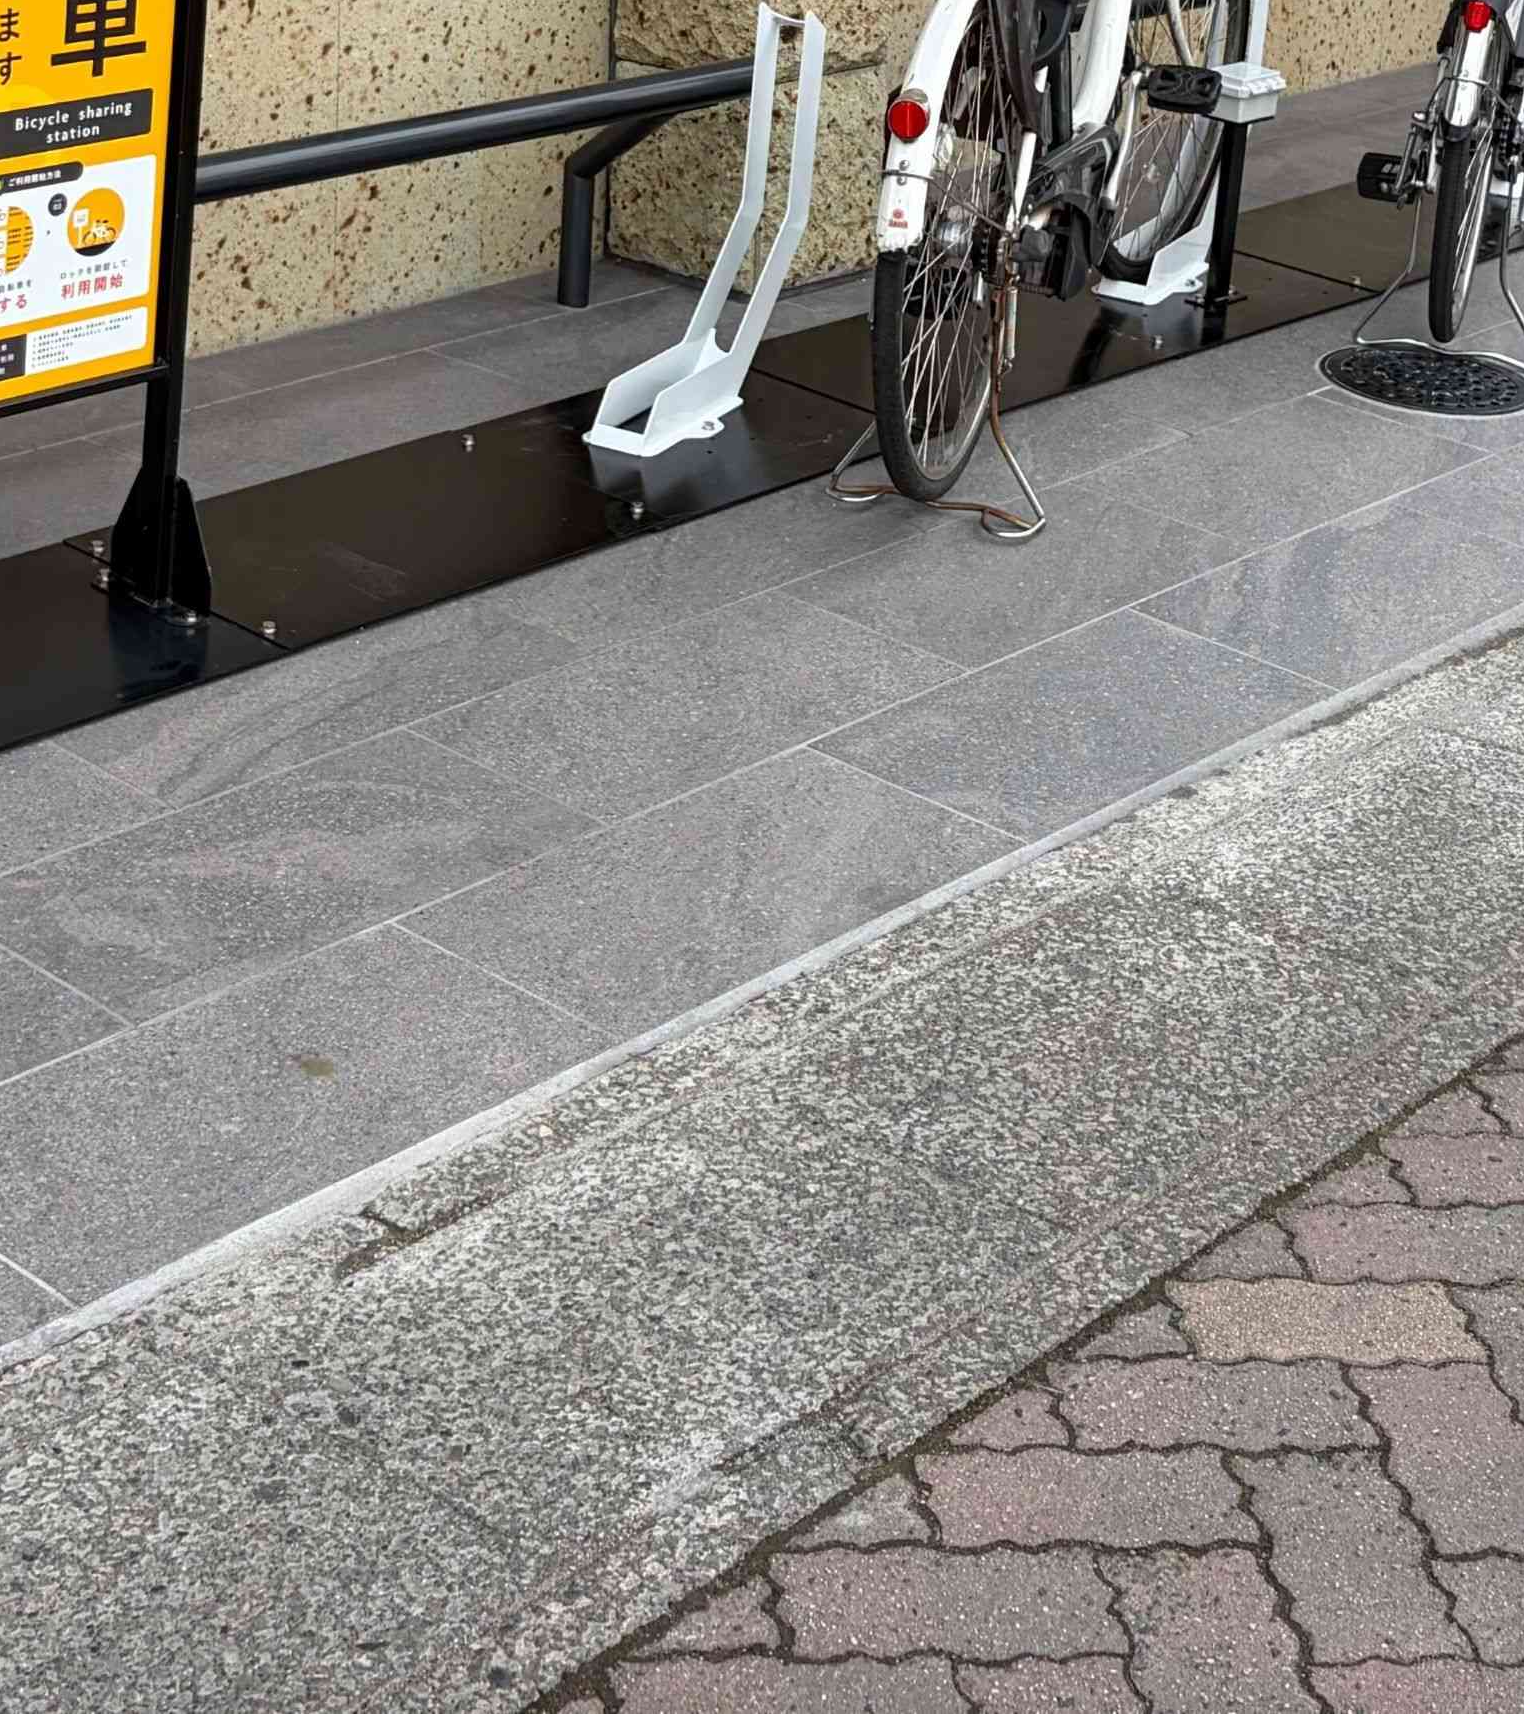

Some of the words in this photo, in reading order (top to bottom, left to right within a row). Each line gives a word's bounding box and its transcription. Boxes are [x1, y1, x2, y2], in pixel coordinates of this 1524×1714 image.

[14, 110, 70, 132] Bicycle
[78, 100, 133, 120] sharing
[45, 124, 100, 144] station
[60, 273, 124, 300] 利用開始
